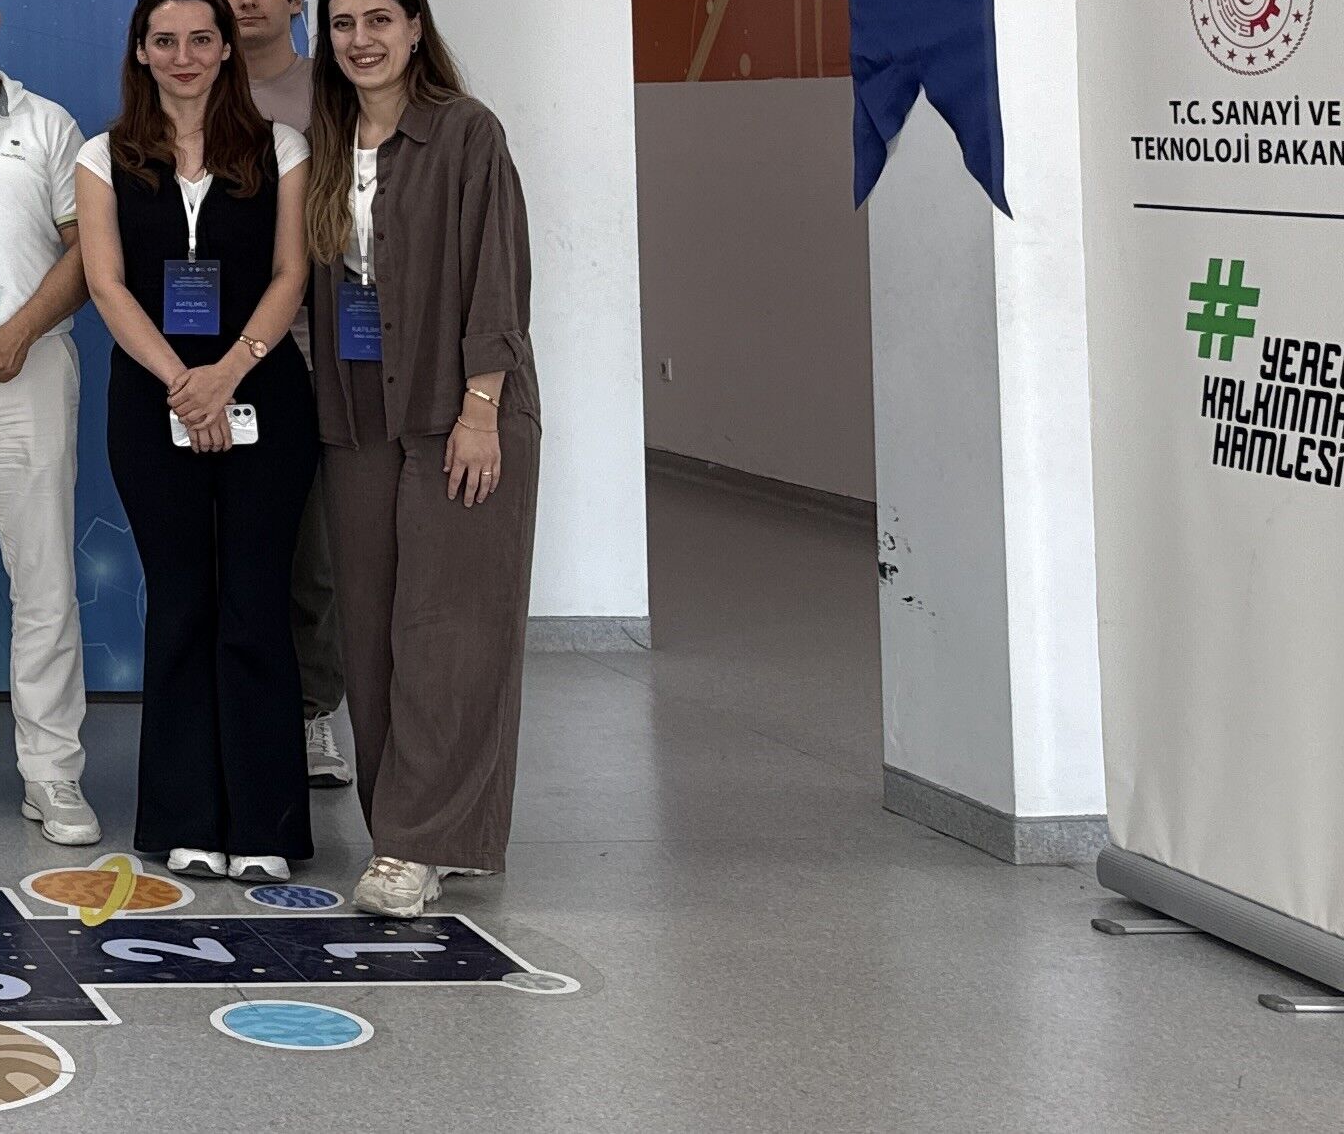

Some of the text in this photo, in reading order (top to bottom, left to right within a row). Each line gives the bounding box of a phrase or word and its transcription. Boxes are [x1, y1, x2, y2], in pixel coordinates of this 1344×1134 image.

[1169, 95, 1341, 126] T.C. SANAYİ VE
[1131, 133, 1250, 164] TEKNOLOJİ
[1260, 336, 1344, 393] YERE
[1212, 422, 1344, 488] HAMLESİ
[101, 937, 236, 963] 2
[323, 942, 447, 960] 1
